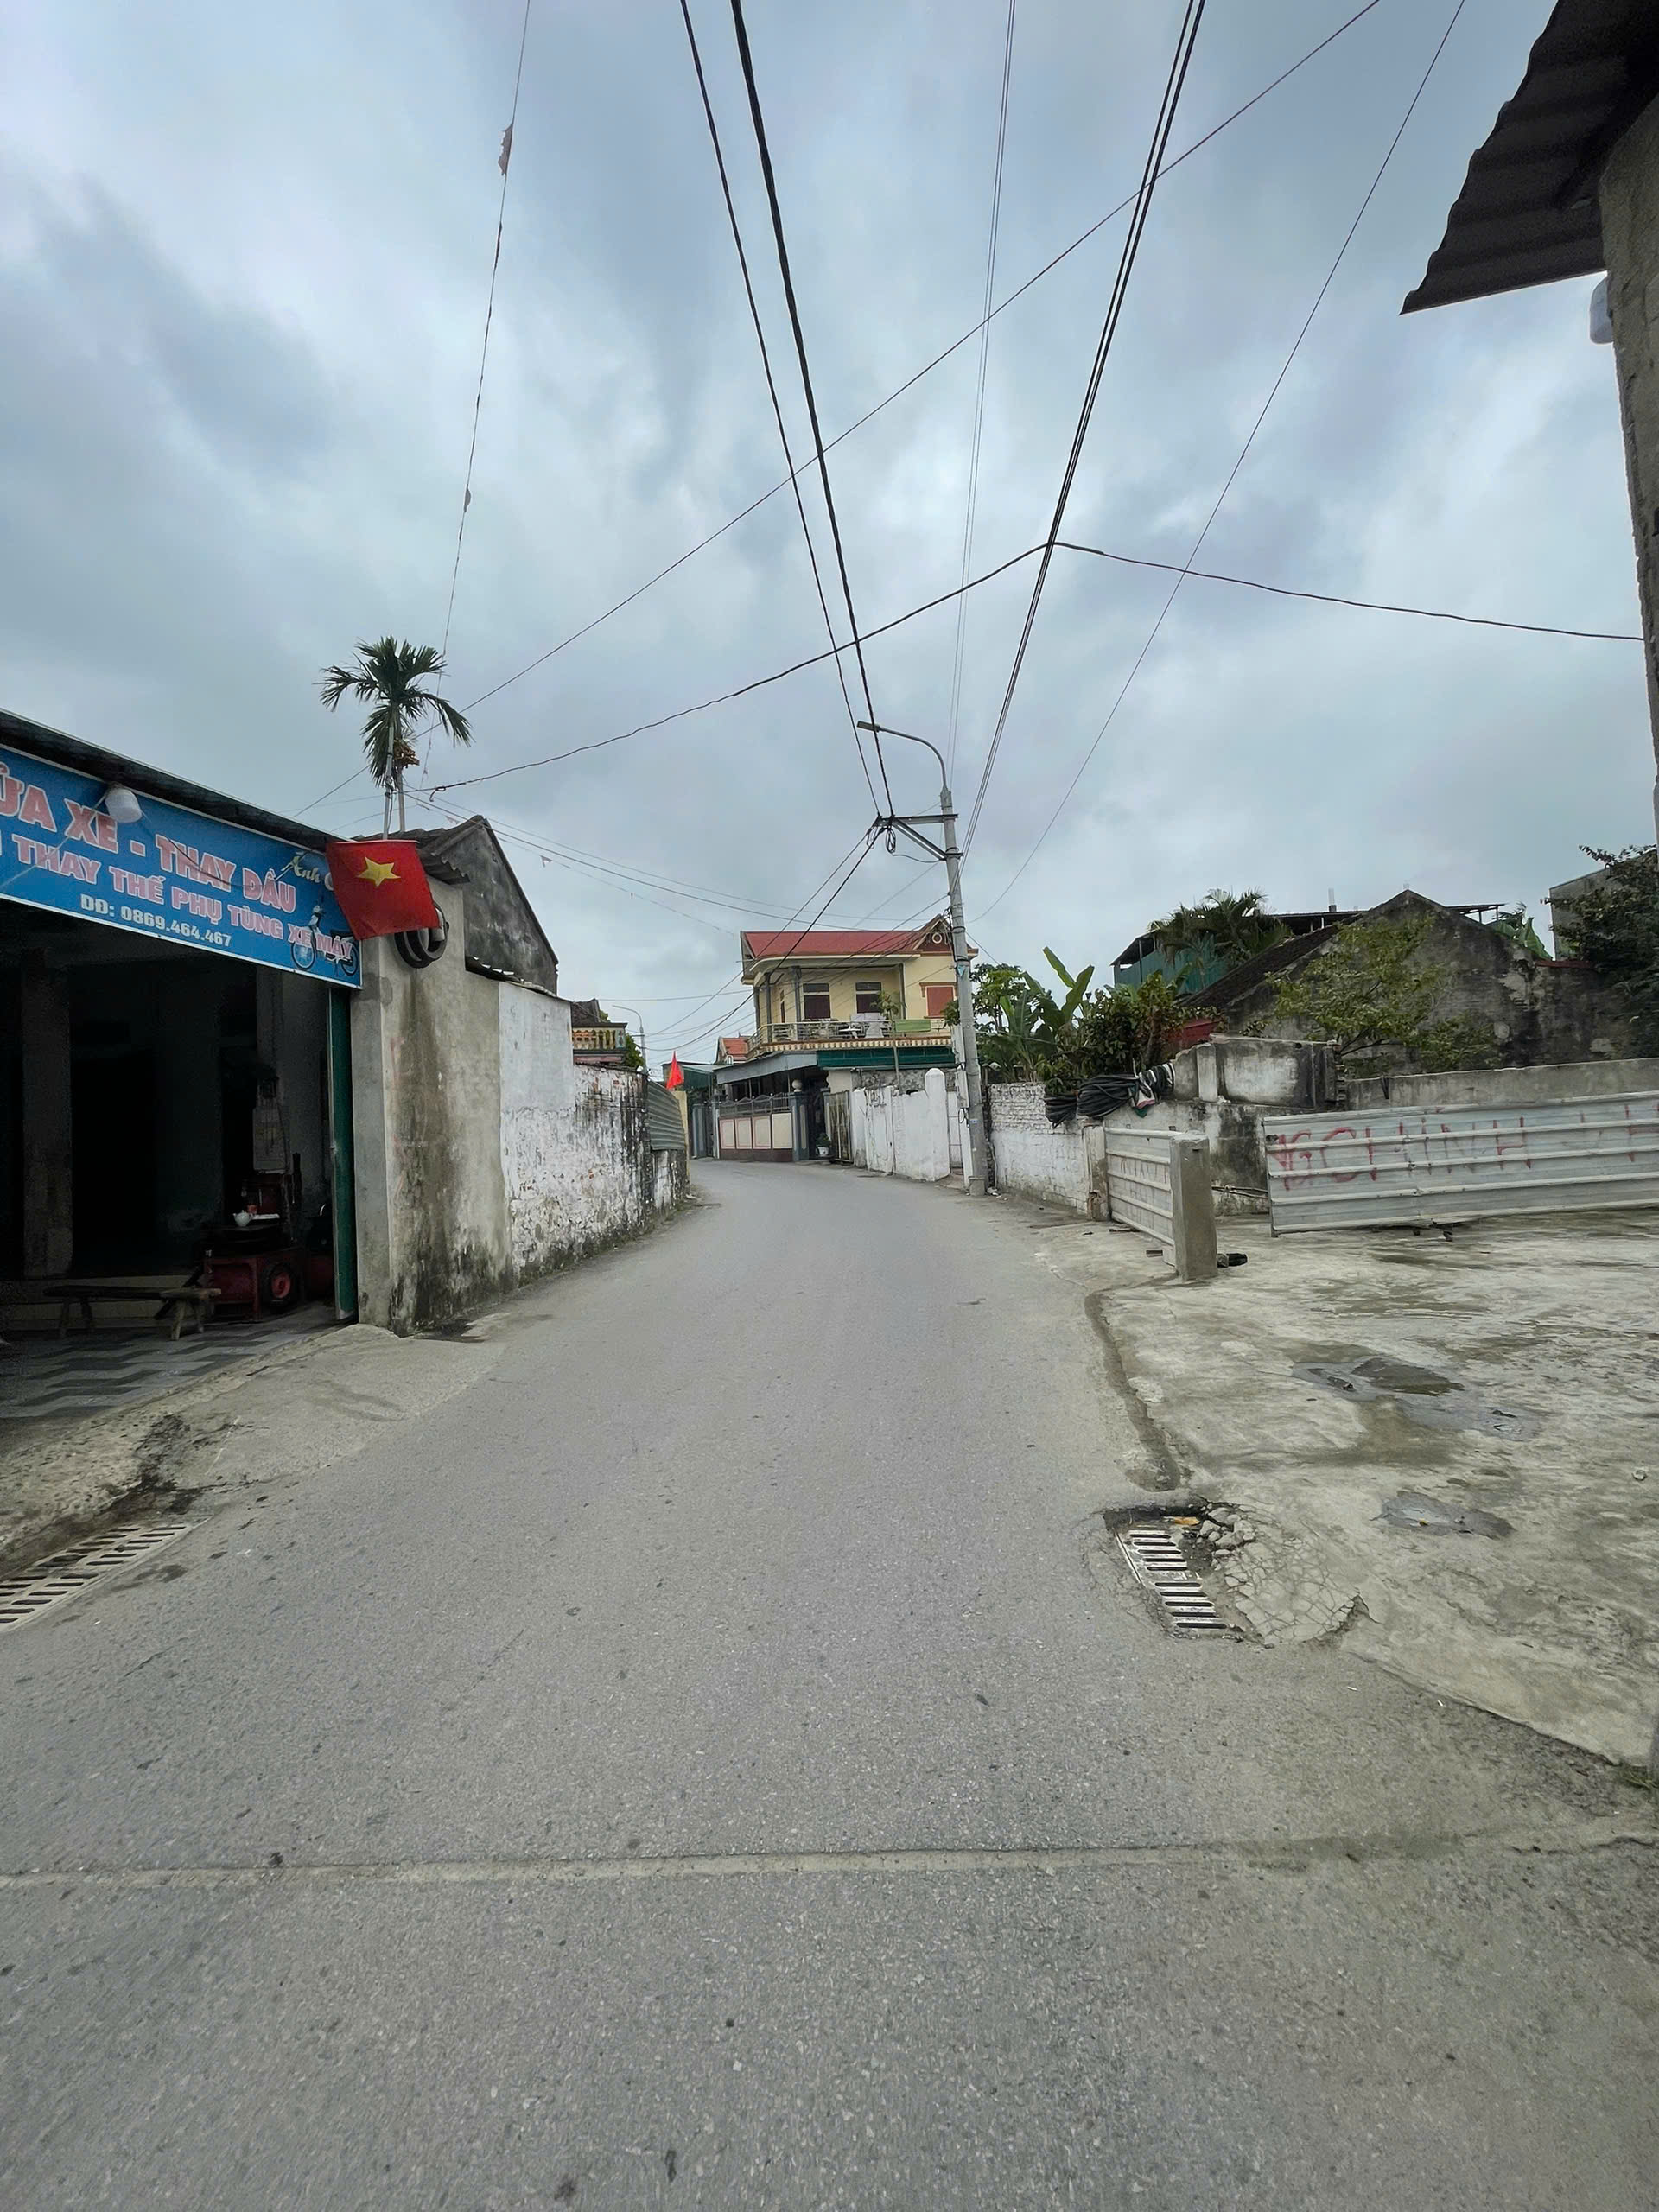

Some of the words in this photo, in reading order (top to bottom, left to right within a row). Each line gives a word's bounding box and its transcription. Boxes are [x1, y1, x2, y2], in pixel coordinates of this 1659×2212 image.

[64, 798, 118, 854] XE
[155, 834, 237, 893] THAY
[11, 833, 102, 885] THAY
[109, 866, 166, 906] THẾ
[171, 886, 223, 925] PHỤ
[227, 903, 284, 940] TÙNG
[288, 923, 314, 949] XE
[315, 933, 353, 960] MÁY
[120, 906, 232, 947] 0869.464.467
